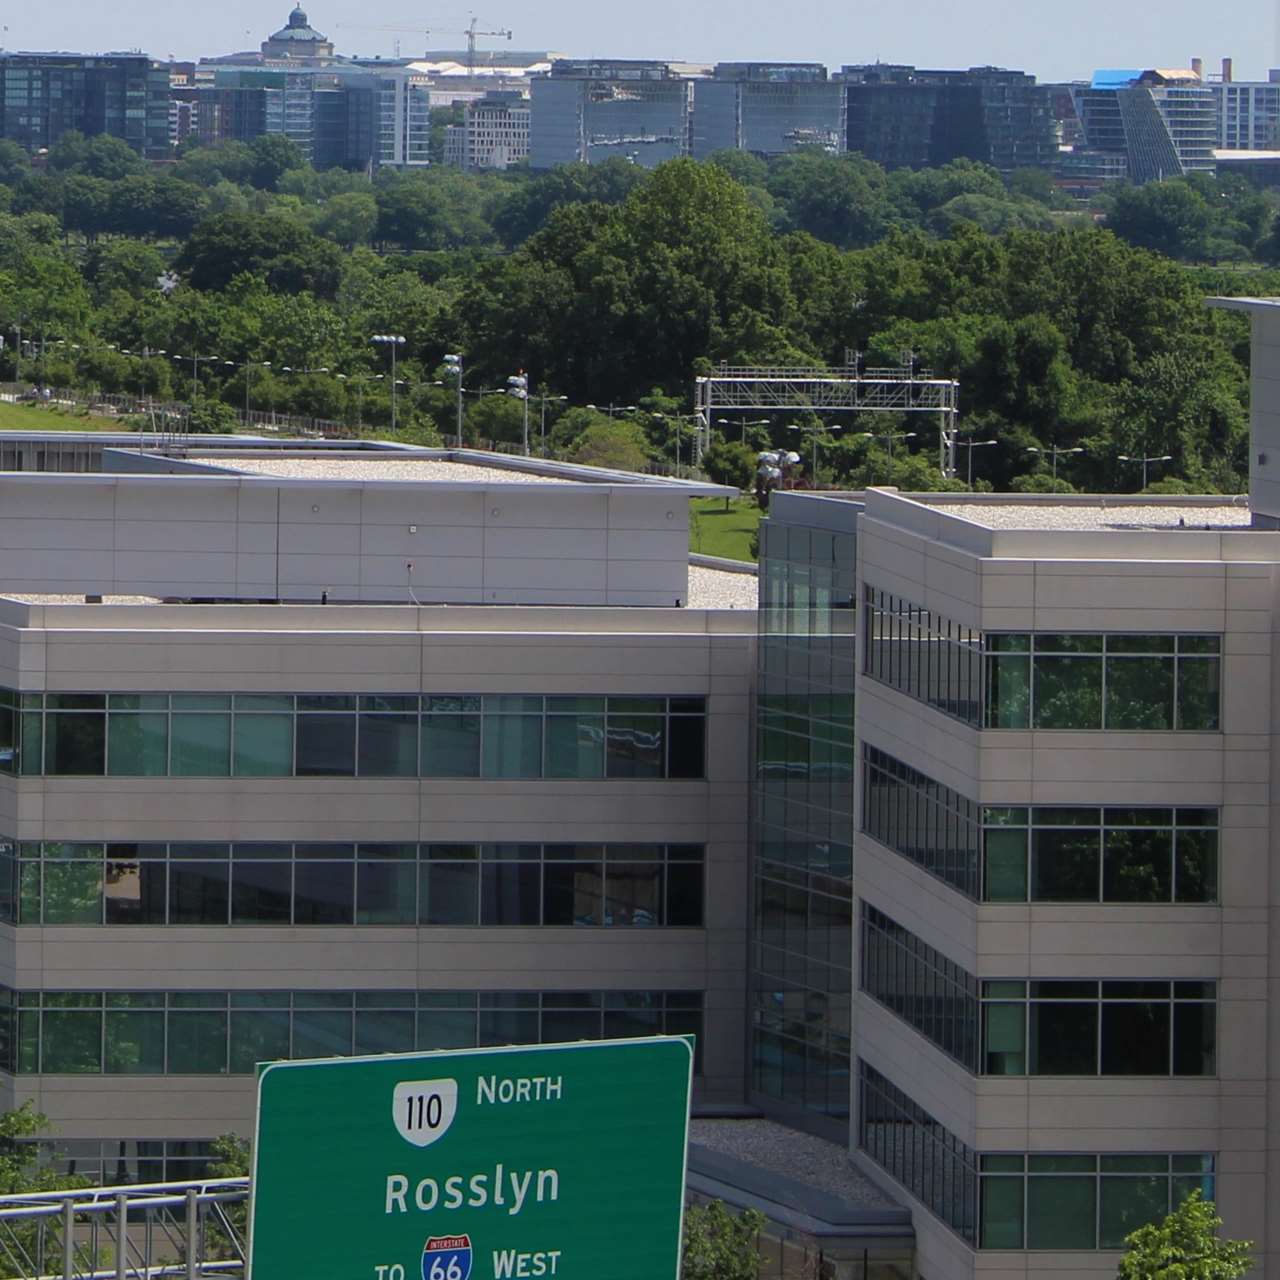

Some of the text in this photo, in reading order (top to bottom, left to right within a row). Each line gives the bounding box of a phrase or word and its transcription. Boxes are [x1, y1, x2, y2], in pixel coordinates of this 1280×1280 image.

[476, 1074, 562, 1105] NORTH
[407, 1093, 442, 1131] 110
[385, 1163, 559, 1216] Rosslyn
[429, 1238, 466, 1250] INTERSTATE
[374, 1263, 405, 1280] TO
[429, 1255, 463, 1280] 66
[492, 1249, 562, 1280] WEST
